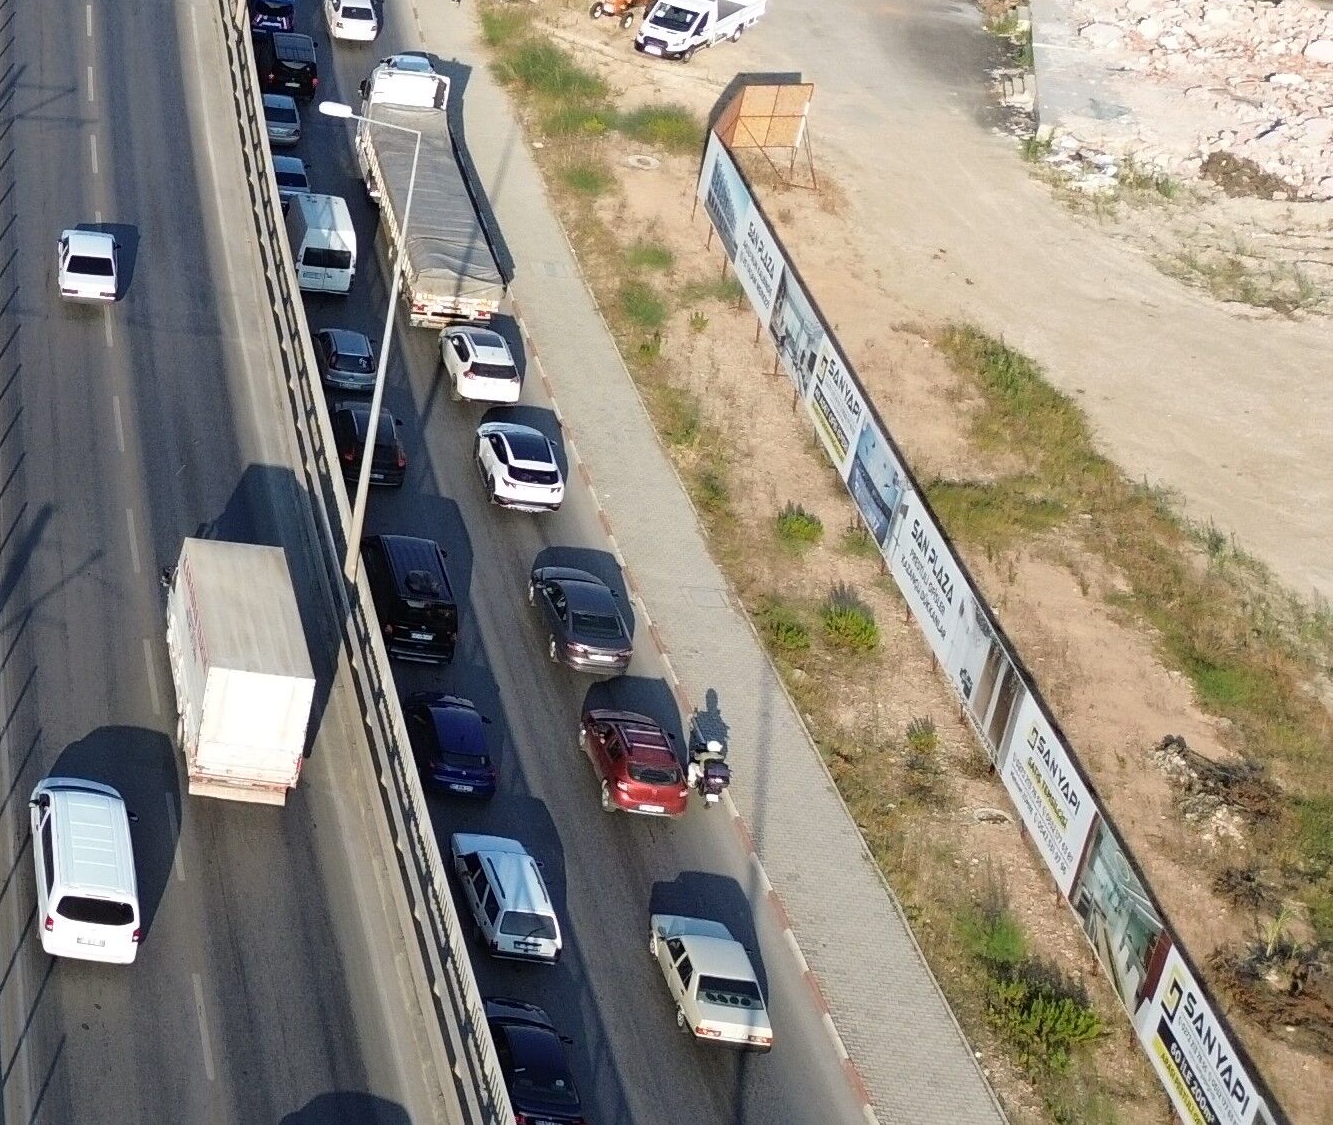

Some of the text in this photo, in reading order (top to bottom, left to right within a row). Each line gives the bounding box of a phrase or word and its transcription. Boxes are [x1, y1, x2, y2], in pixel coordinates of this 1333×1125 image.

[911, 516, 954, 605] SAN PLAZA
[1036, 733, 1080, 817] SANYAPI
[1179, 989, 1251, 1117] SANYAPI
